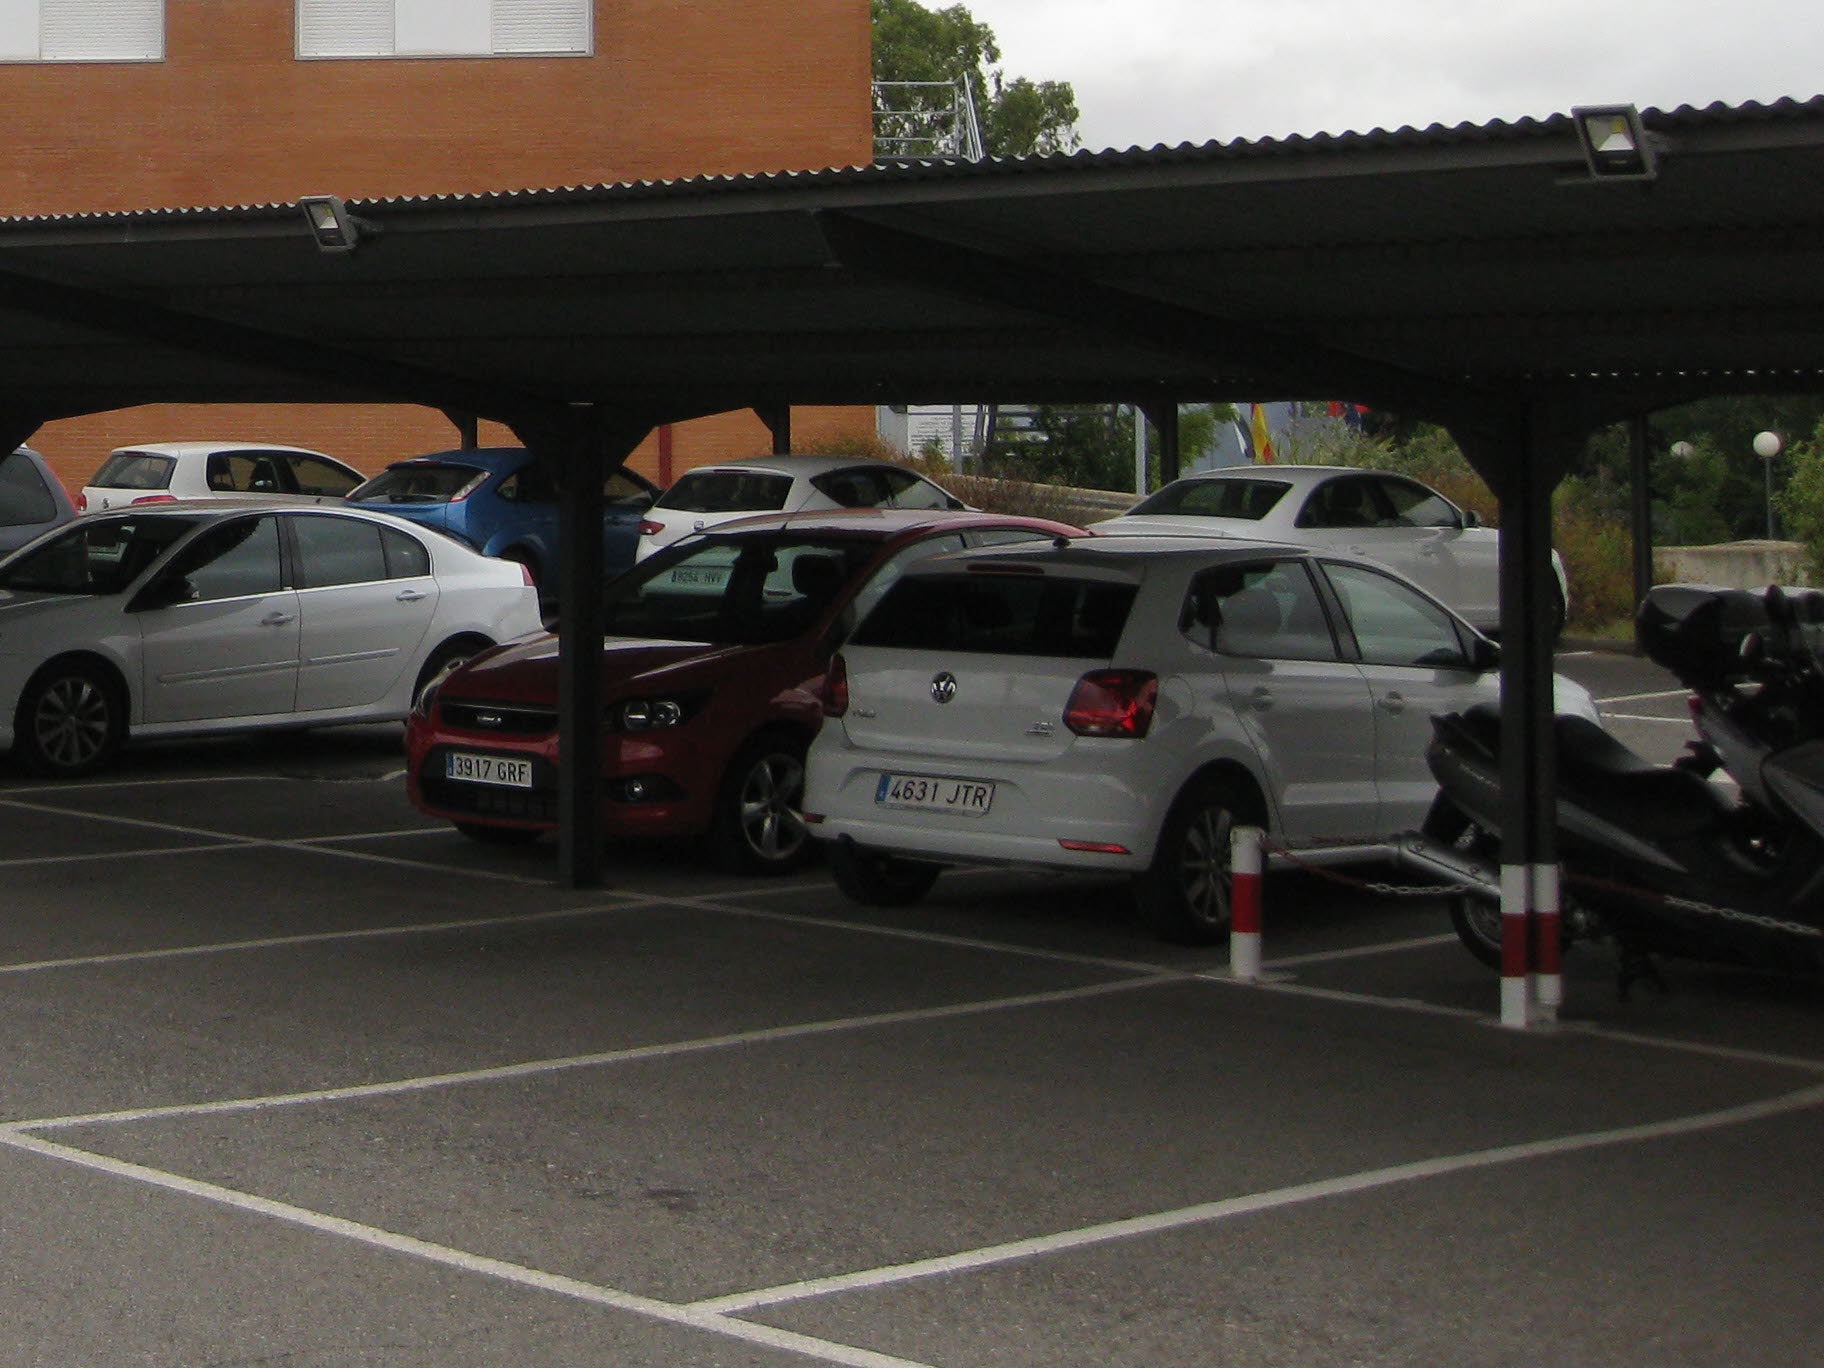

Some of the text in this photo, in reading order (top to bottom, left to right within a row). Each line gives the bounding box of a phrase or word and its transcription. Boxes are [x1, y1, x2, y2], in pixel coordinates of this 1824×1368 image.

[455, 756, 528, 783] 3917 GRF
[890, 778, 987, 808] 4631 JTR
